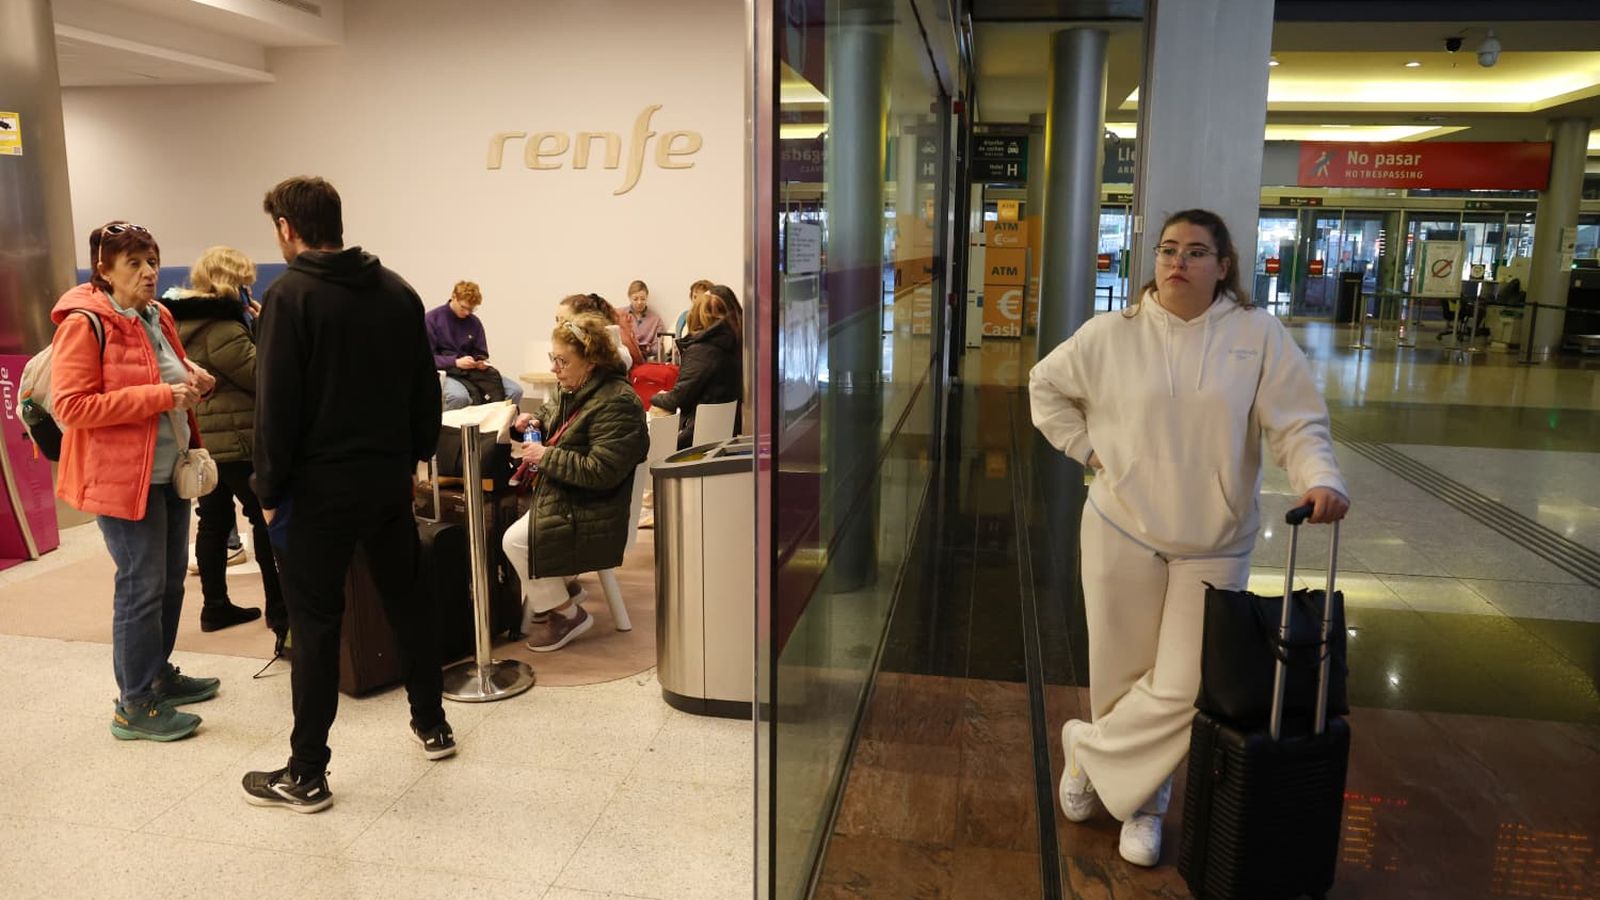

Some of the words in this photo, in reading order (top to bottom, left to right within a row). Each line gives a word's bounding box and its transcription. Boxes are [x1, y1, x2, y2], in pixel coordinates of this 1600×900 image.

[486, 104, 703, 196] renfe
[1348, 150, 1369, 165] No
[1375, 152, 1422, 168] pasar
[1345, 170, 1358, 178] NO
[1360, 171, 1423, 179] TRESPASSING
[994, 223, 1018, 231] ATM
[992, 266, 1018, 275] ATM
[982, 322, 1020, 336] Cash
[0, 367, 14, 420] renfe
